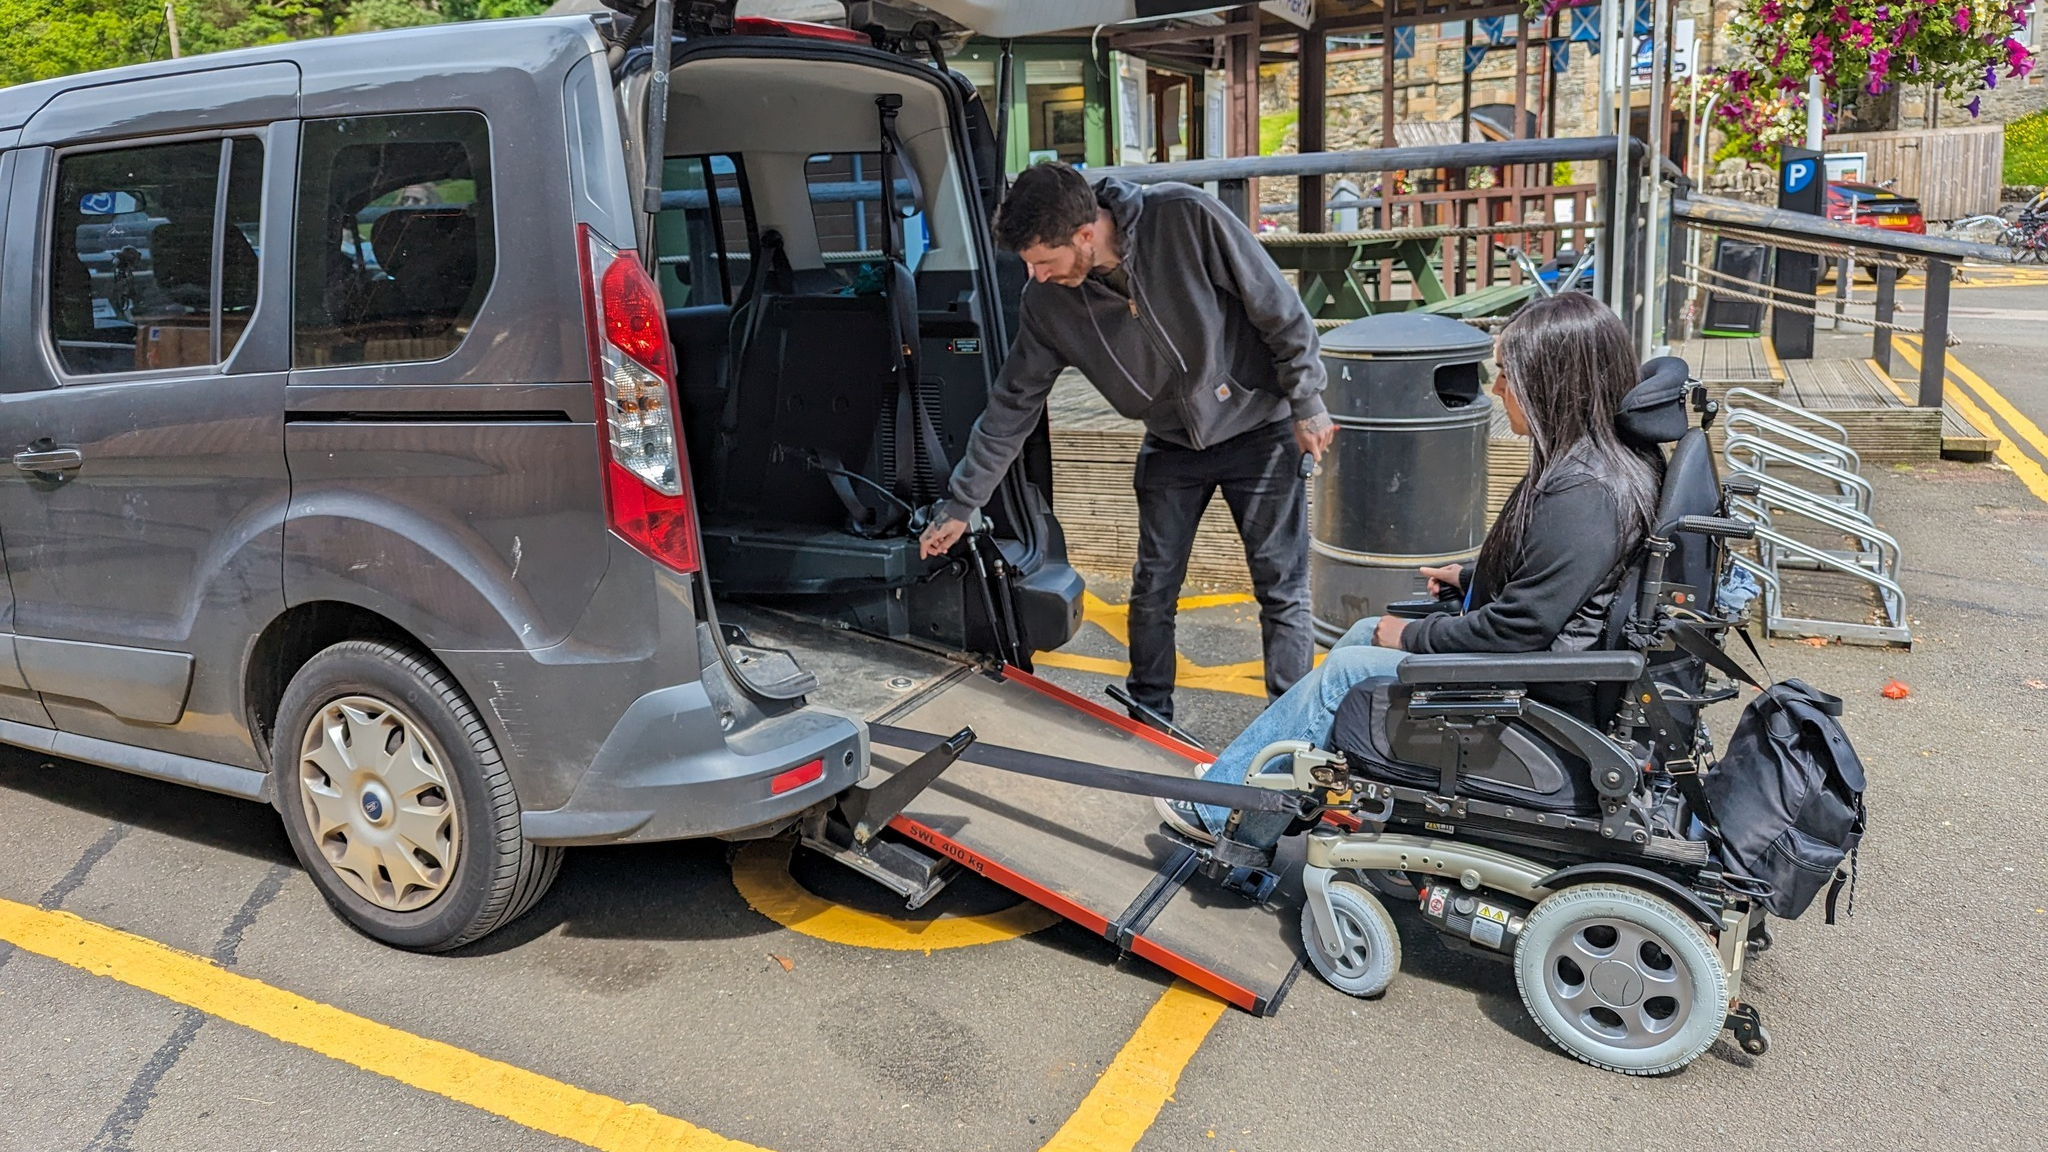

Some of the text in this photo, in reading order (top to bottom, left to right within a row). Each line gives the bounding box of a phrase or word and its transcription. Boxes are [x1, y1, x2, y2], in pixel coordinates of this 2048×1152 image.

[1789, 163, 1807, 187] P
[910, 826, 984, 872] SWL 400 kg
